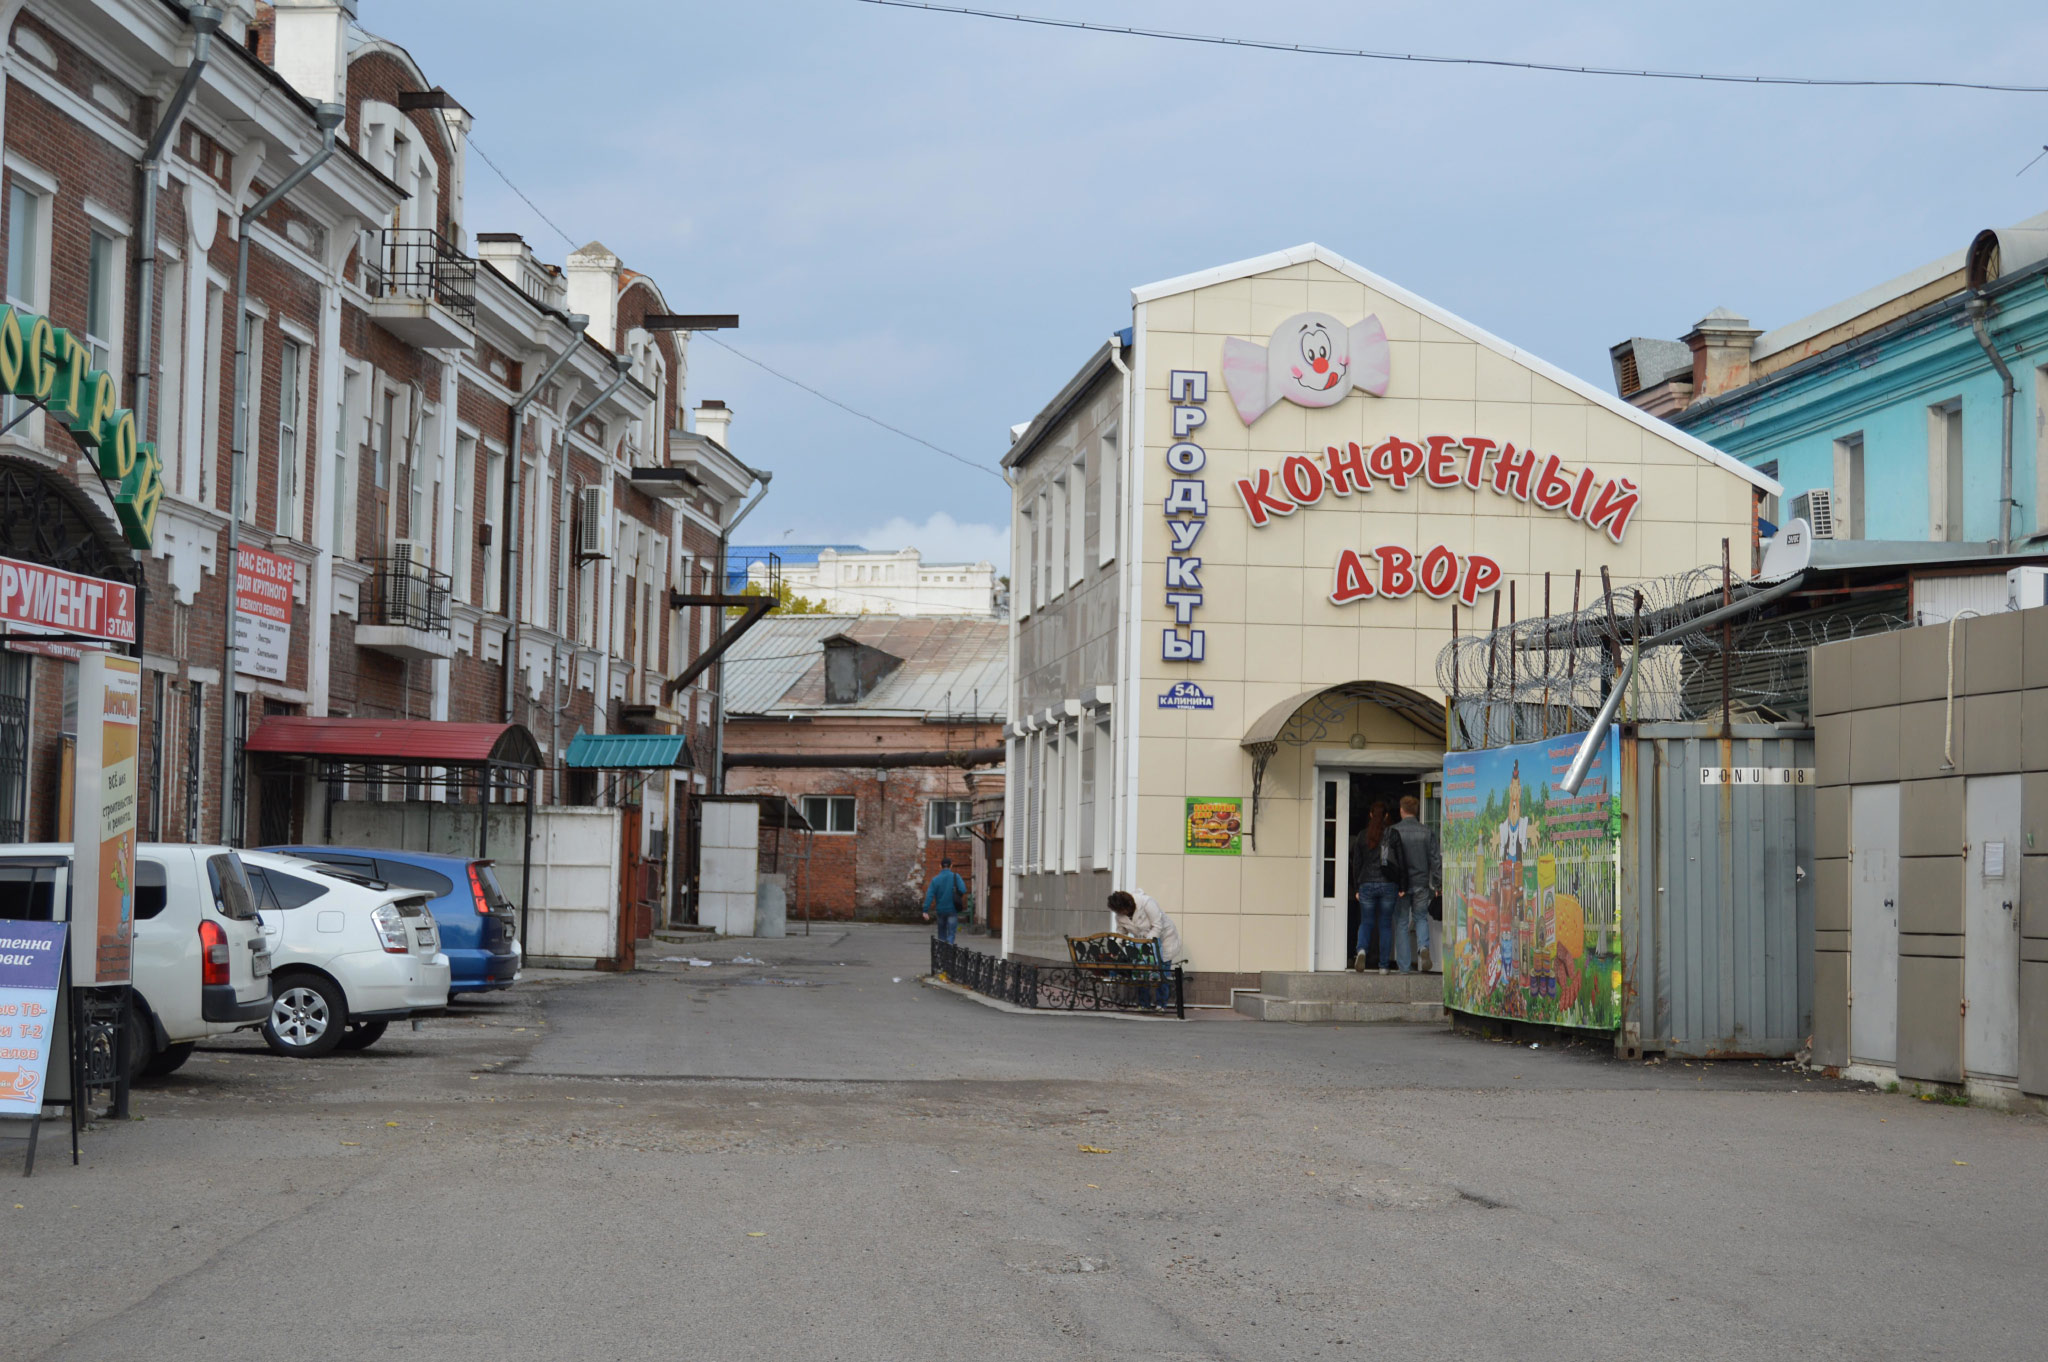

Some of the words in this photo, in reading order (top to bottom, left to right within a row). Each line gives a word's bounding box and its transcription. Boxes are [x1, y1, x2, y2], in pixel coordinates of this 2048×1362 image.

[1234, 434, 1641, 544] КОНФЕТНЫЙ
[1162, 369, 1208, 662] ПРОДУКТЫ
[256, 555, 276, 577] ЕСТЬ
[277, 561, 294, 583] ВСЁ
[1329, 544, 1502, 607] ДВОР
[0, 563, 104, 631] РУМЕНТ
[237, 573, 252, 592] ДЛЯ
[252, 579, 288, 602] КРУПНОГО
[118, 588, 127, 617] 2
[240, 598, 263, 613] МЕЛКОГО
[263, 603, 285, 620] РЕМОНТА
[107, 617, 134, 638] ЭТАЖ
[1160, 697, 1212, 706] КАЛИНИНА
[108, 770, 118, 790] ВСЁ
[1702, 769, 1760, 783] PONU
[102, 794, 133, 819] строительство
[21, 1002, 47, 1016] ТВ-
[20, 1023, 43, 1039] Т-2
